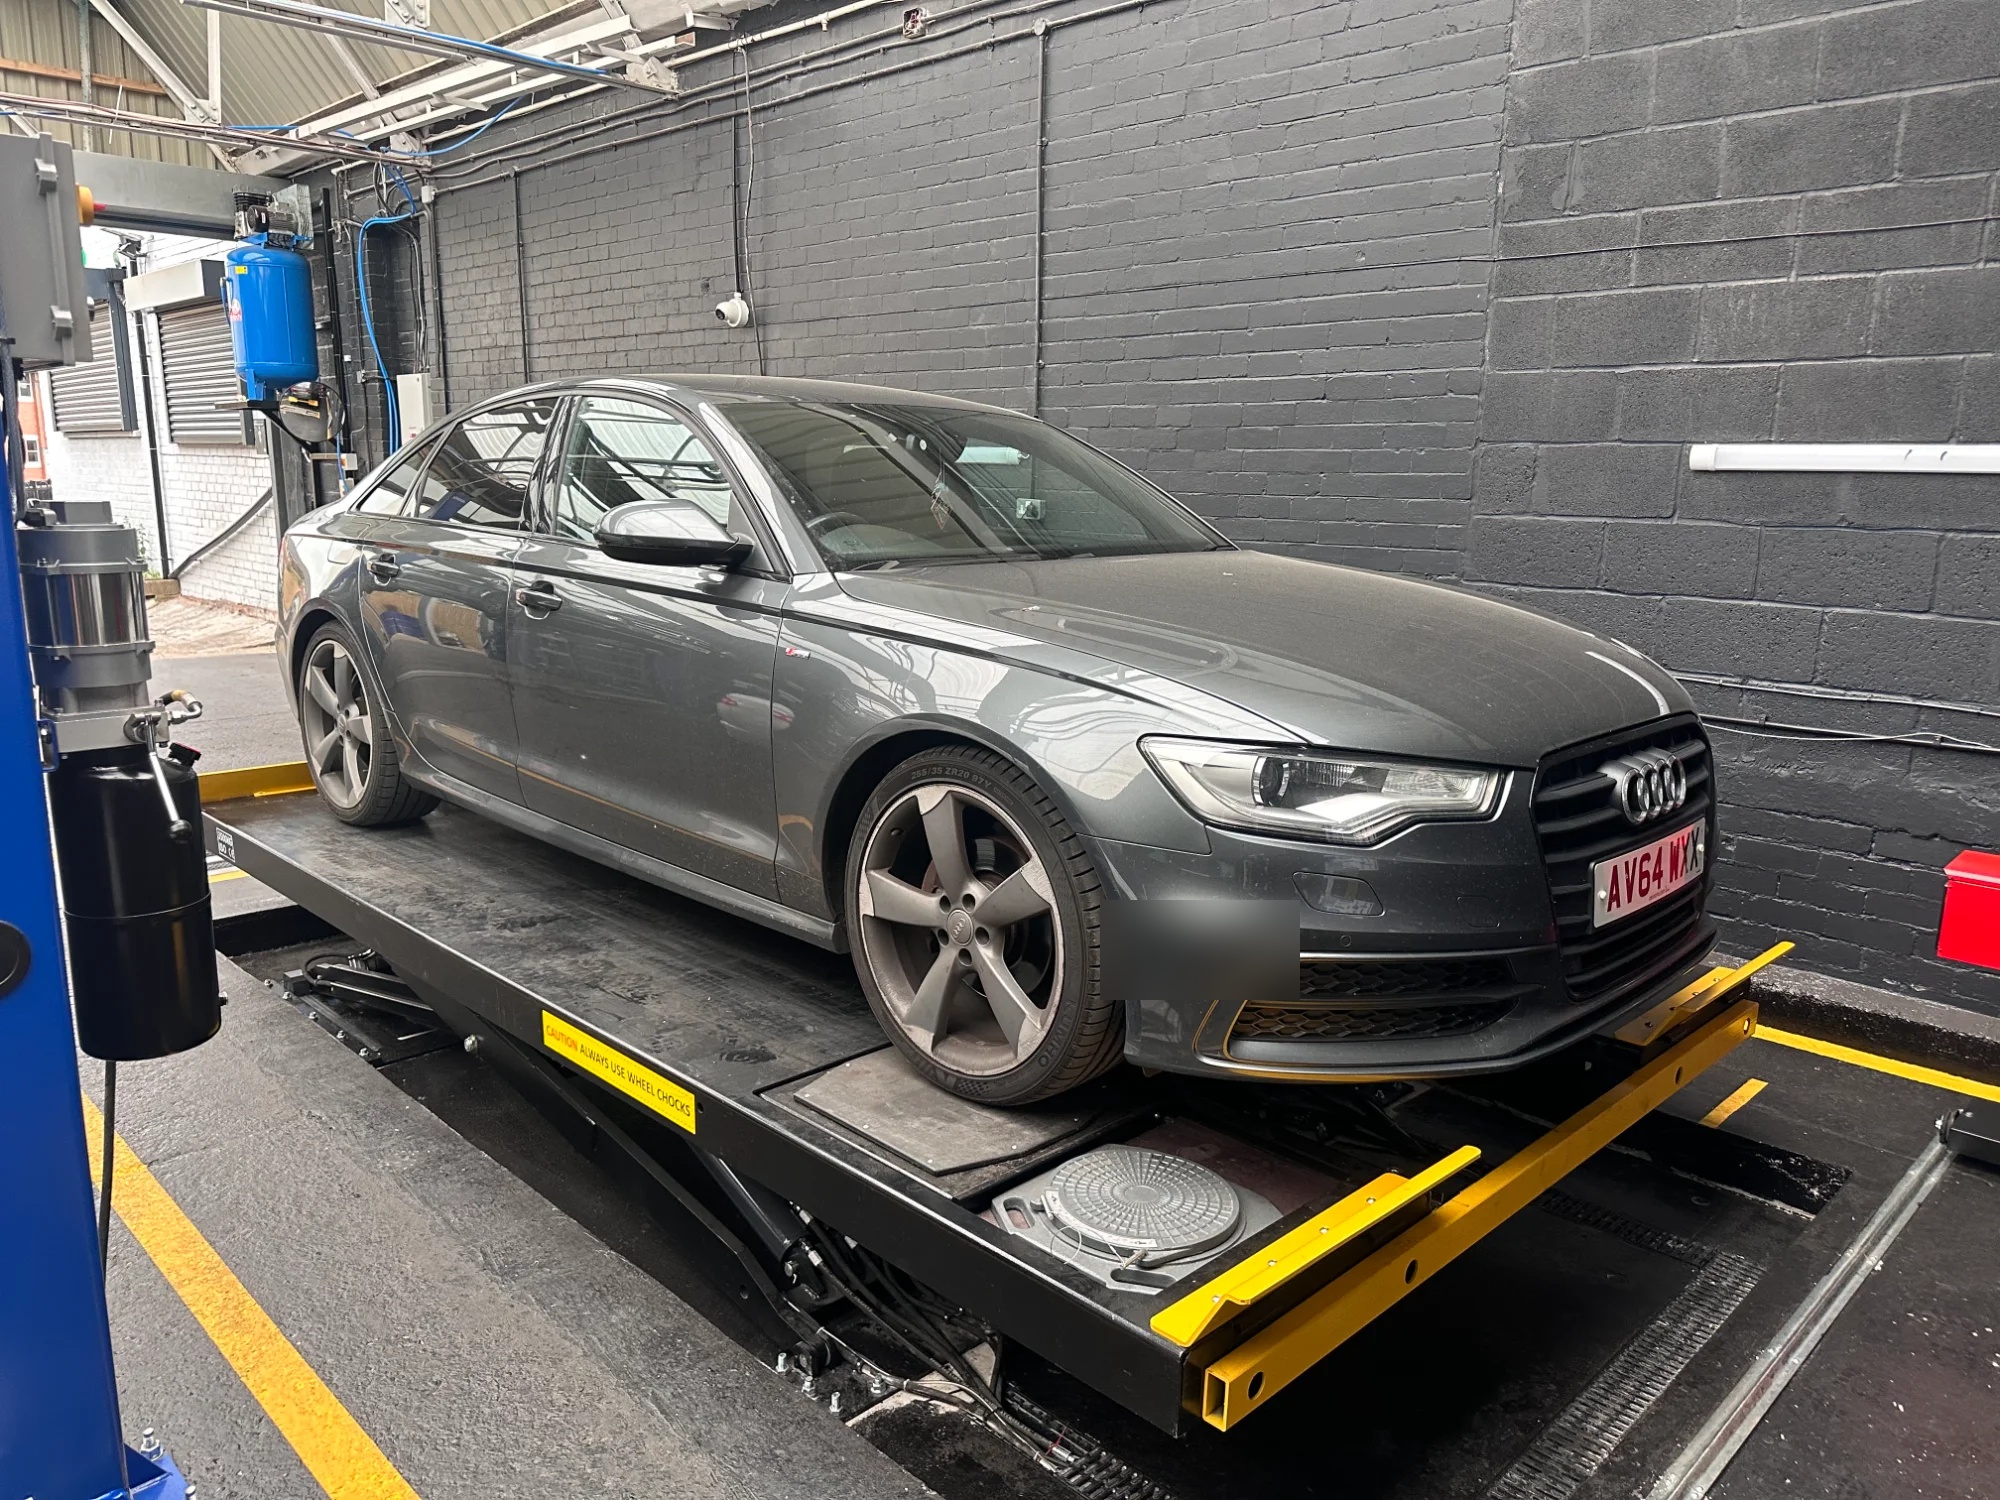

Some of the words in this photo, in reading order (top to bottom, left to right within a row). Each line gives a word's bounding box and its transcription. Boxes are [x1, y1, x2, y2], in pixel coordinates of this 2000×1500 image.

[911, 766, 943, 780] 255/35
[945, 766, 970, 779] ZR20
[1607, 846, 1664, 913] AV64
[1669, 826, 1700, 883] WXX
[546, 1025, 578, 1052] CAUTION
[580, 1044, 609, 1069] ALWAYS
[611, 1061, 626, 1079] USE
[627, 1070, 655, 1097] WHEEL
[657, 1089, 691, 1117] CHOCKS
[1039, 999, 1077, 1068] KUMHO
